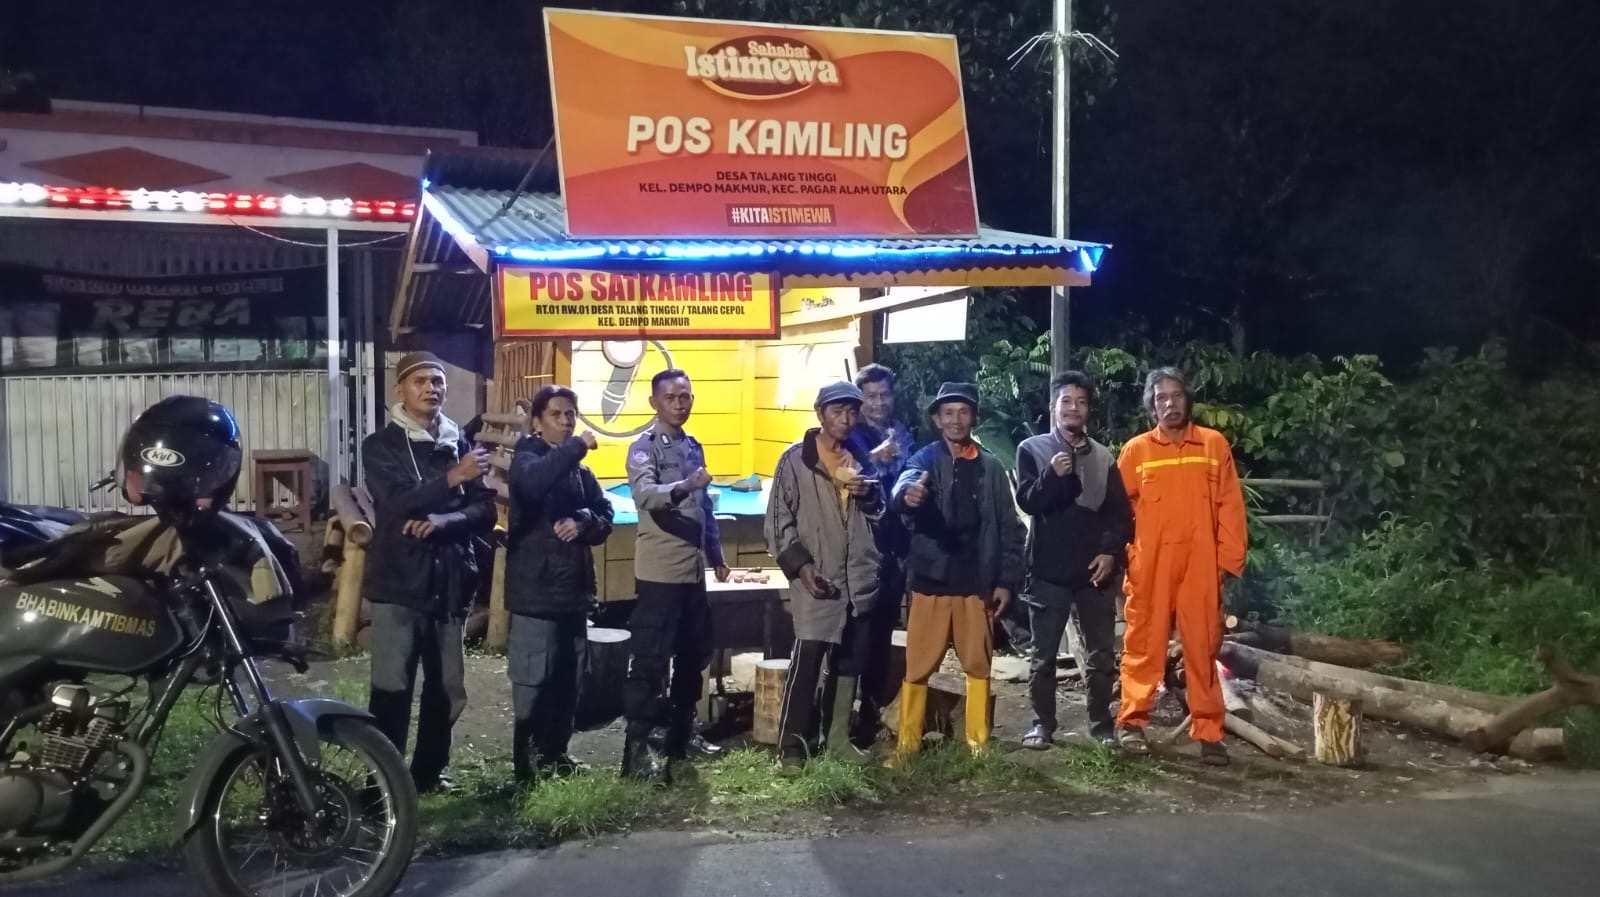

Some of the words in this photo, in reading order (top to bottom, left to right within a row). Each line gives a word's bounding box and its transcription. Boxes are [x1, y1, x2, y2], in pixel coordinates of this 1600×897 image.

[748, 41, 809, 59] Sahabat
[685, 46, 839, 85] Istimewa
[627, 115, 712, 155] POS
[727, 119, 908, 159] KAMLING
[716, 170, 748, 181] DESA
[749, 171, 796, 182] TALANG
[798, 172, 836, 183] TINGGI
[639, 183, 667, 194] KEL.
[669, 184, 713, 195] DEMPO
[714, 184, 770, 196] MAKMUR,
[772, 184, 798, 195] KEC.
[800, 185, 838, 195] PAGAR
[839, 185, 870, 196] ALAM
[871, 185, 907, 196] UTARA
[731, 207, 831, 225] #KITAISTIMEWA
[529, 272, 583, 301] POS
[591, 272, 752, 302] SATKAMLING
[536, 305, 560, 315] RT.01
[562, 305, 590, 315] RW.01
[591, 305, 614, 315] DESA
[615, 305, 648, 315] TALANG
[650, 305, 679, 314] TINGGI
[687, 305, 718, 314] TALANG
[720, 305, 745, 314] CEPOL
[619, 317, 649, 327] DEMPO
[651, 317, 690, 327] MAKMUR
[16, 592, 156, 637] BHABINKAMTIBMAS
